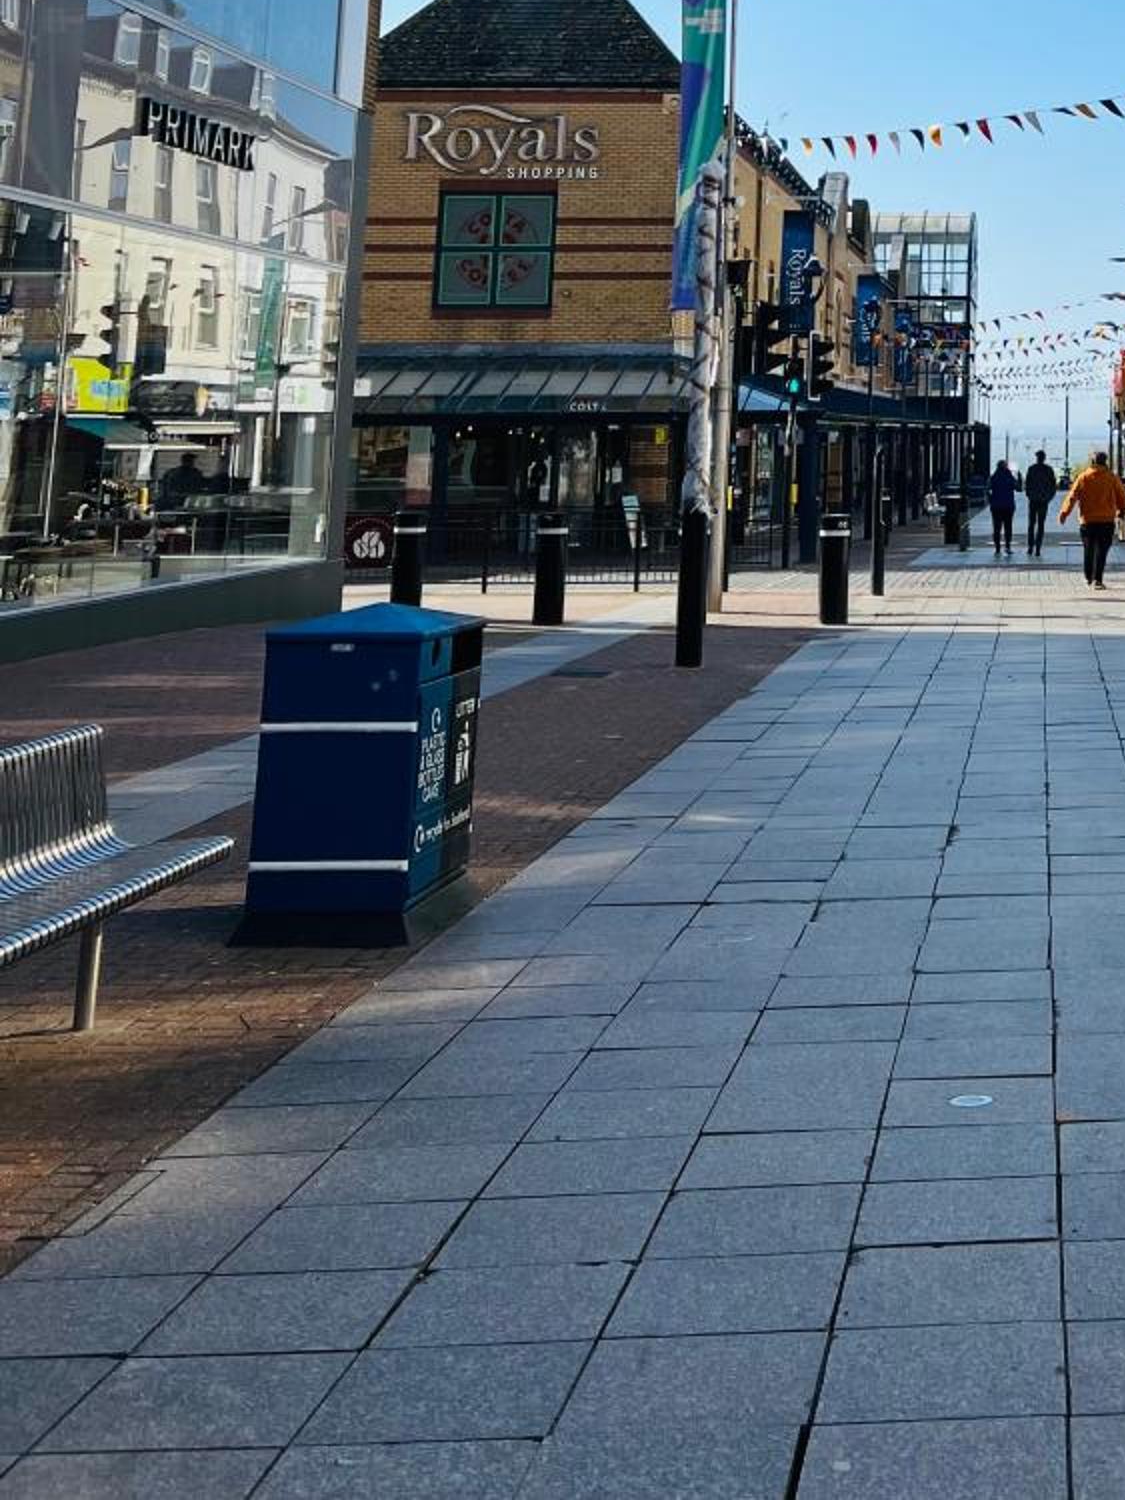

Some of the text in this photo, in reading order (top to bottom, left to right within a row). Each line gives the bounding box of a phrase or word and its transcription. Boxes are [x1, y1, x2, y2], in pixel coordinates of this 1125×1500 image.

[142, 98, 256, 171] PRIMARK
[404, 105, 601, 175] Royals
[506, 166, 599, 179] SHOPPING
[787, 249, 807, 305] Royals
